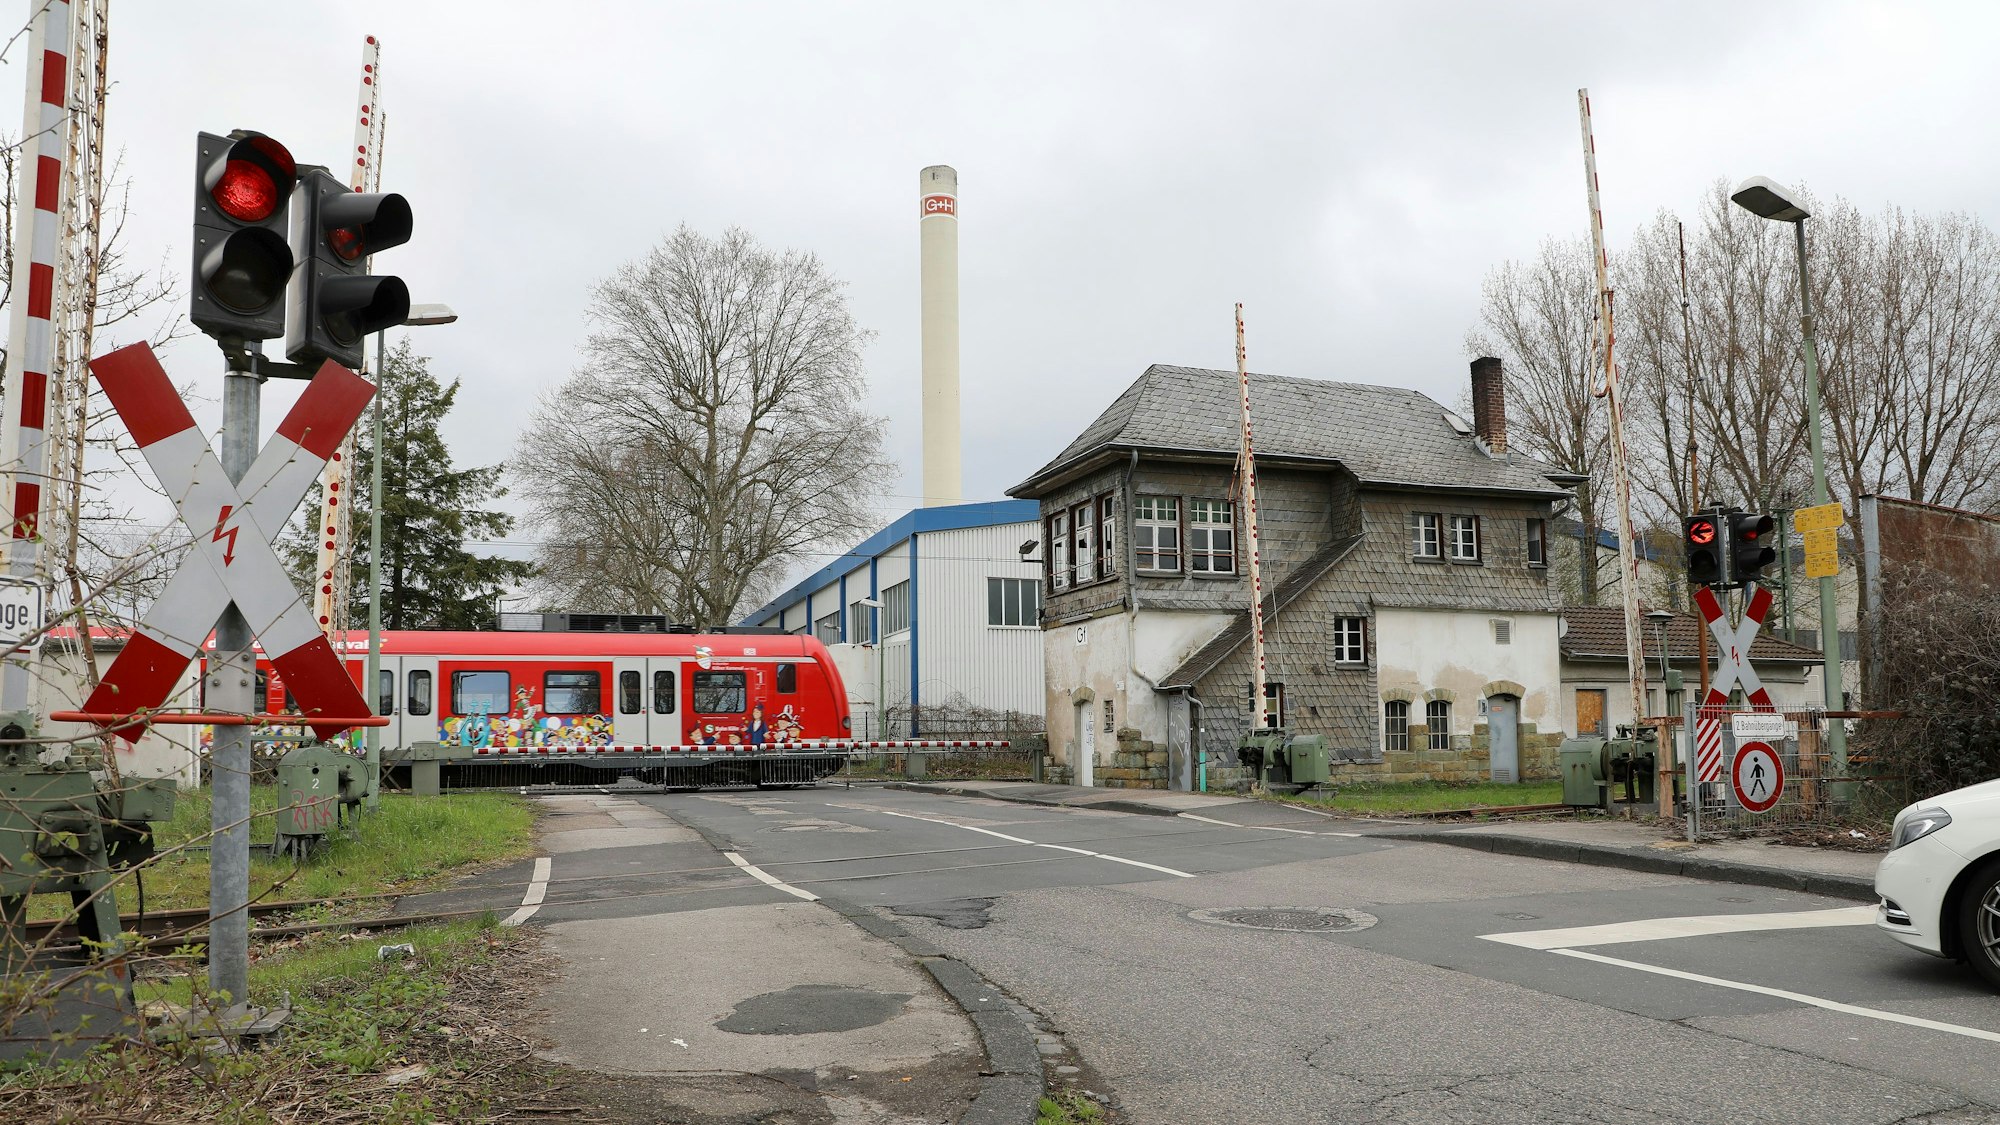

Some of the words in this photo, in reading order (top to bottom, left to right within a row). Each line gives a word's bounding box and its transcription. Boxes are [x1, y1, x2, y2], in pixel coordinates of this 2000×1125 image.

[926, 198, 953, 212] G+H
[0, 603, 28, 630] ge
[756, 671, 764, 684] 1
[1736, 720, 1741, 731] 2
[1741, 720, 1783, 734] Bahnübergänge
[311, 778, 320, 789] 2
